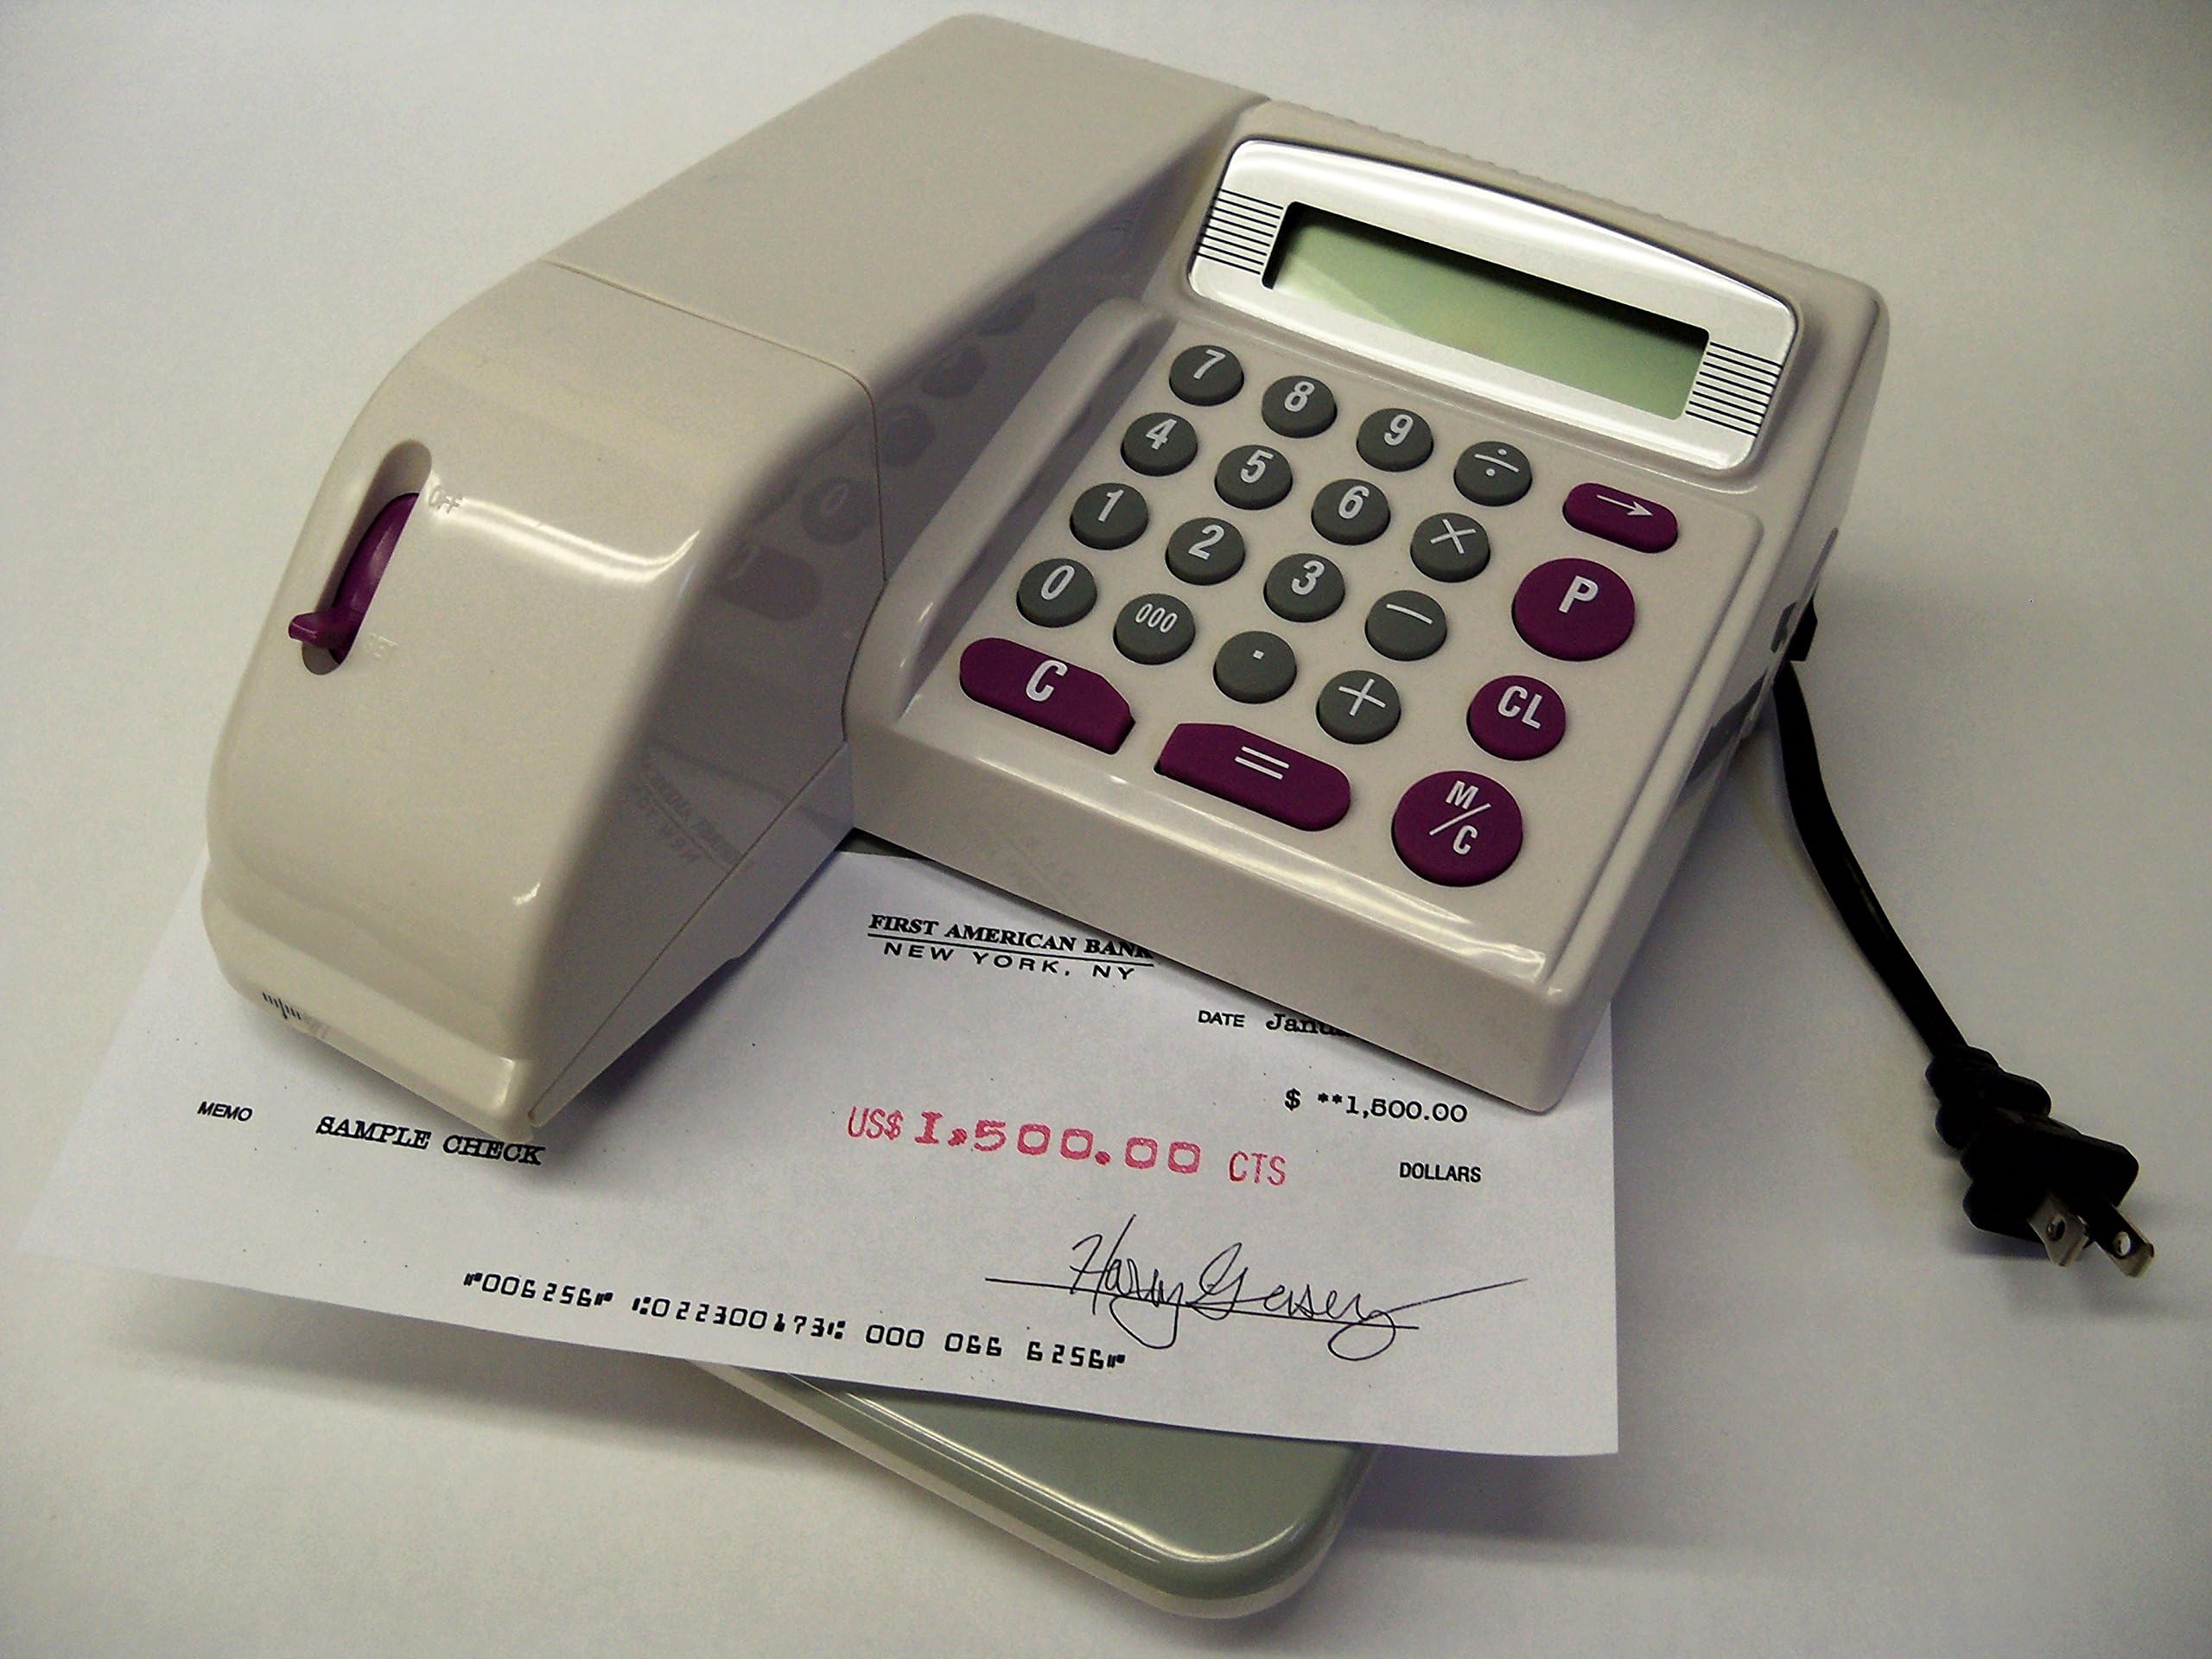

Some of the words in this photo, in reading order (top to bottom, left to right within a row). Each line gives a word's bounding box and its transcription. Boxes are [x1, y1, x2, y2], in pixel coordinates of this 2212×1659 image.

[1193, 349, 1226, 380] 7
[1284, 381, 1315, 412] 8
[1146, 418, 1177, 450] 4
[1384, 414, 1414, 446] 9
[1240, 449, 1274, 484] 5
[1097, 489, 1124, 523] 1
[1338, 486, 1370, 519] 6
[1188, 524, 1225, 561] 2
[1040, 565, 1076, 601] 0
[1291, 560, 1325, 595] 3
[1558, 575, 1599, 613] P
[1135, 603, 1178, 633] 000
[1025, 659, 1069, 702] C
[1497, 685, 1543, 729] CL
[868, 914, 939, 936] FIRST
[944, 924, 1077, 951] AMERICAN
[1084, 938, 1154, 959] BANK
[883, 942, 955, 962] NEW
[972, 951, 1071, 976] YORK,
[1092, 965, 1135, 980] NY
[1198, 1009, 1245, 1028] DATE
[1265, 1013, 1351, 1037] Janu
[1284, 1088, 1301, 1111] $
[197, 1101, 253, 1122] MEMO
[315, 1116, 432, 1150] SAMPLE
[442, 1135, 546, 1166] CHECK
[848, 1106, 904, 1141] US$
[1228, 1150, 1287, 1186] CTS
[1399, 1161, 1482, 1184] DOLLARS
[865, 1325, 925, 1349] 000
[944, 1333, 1002, 1357] 066
